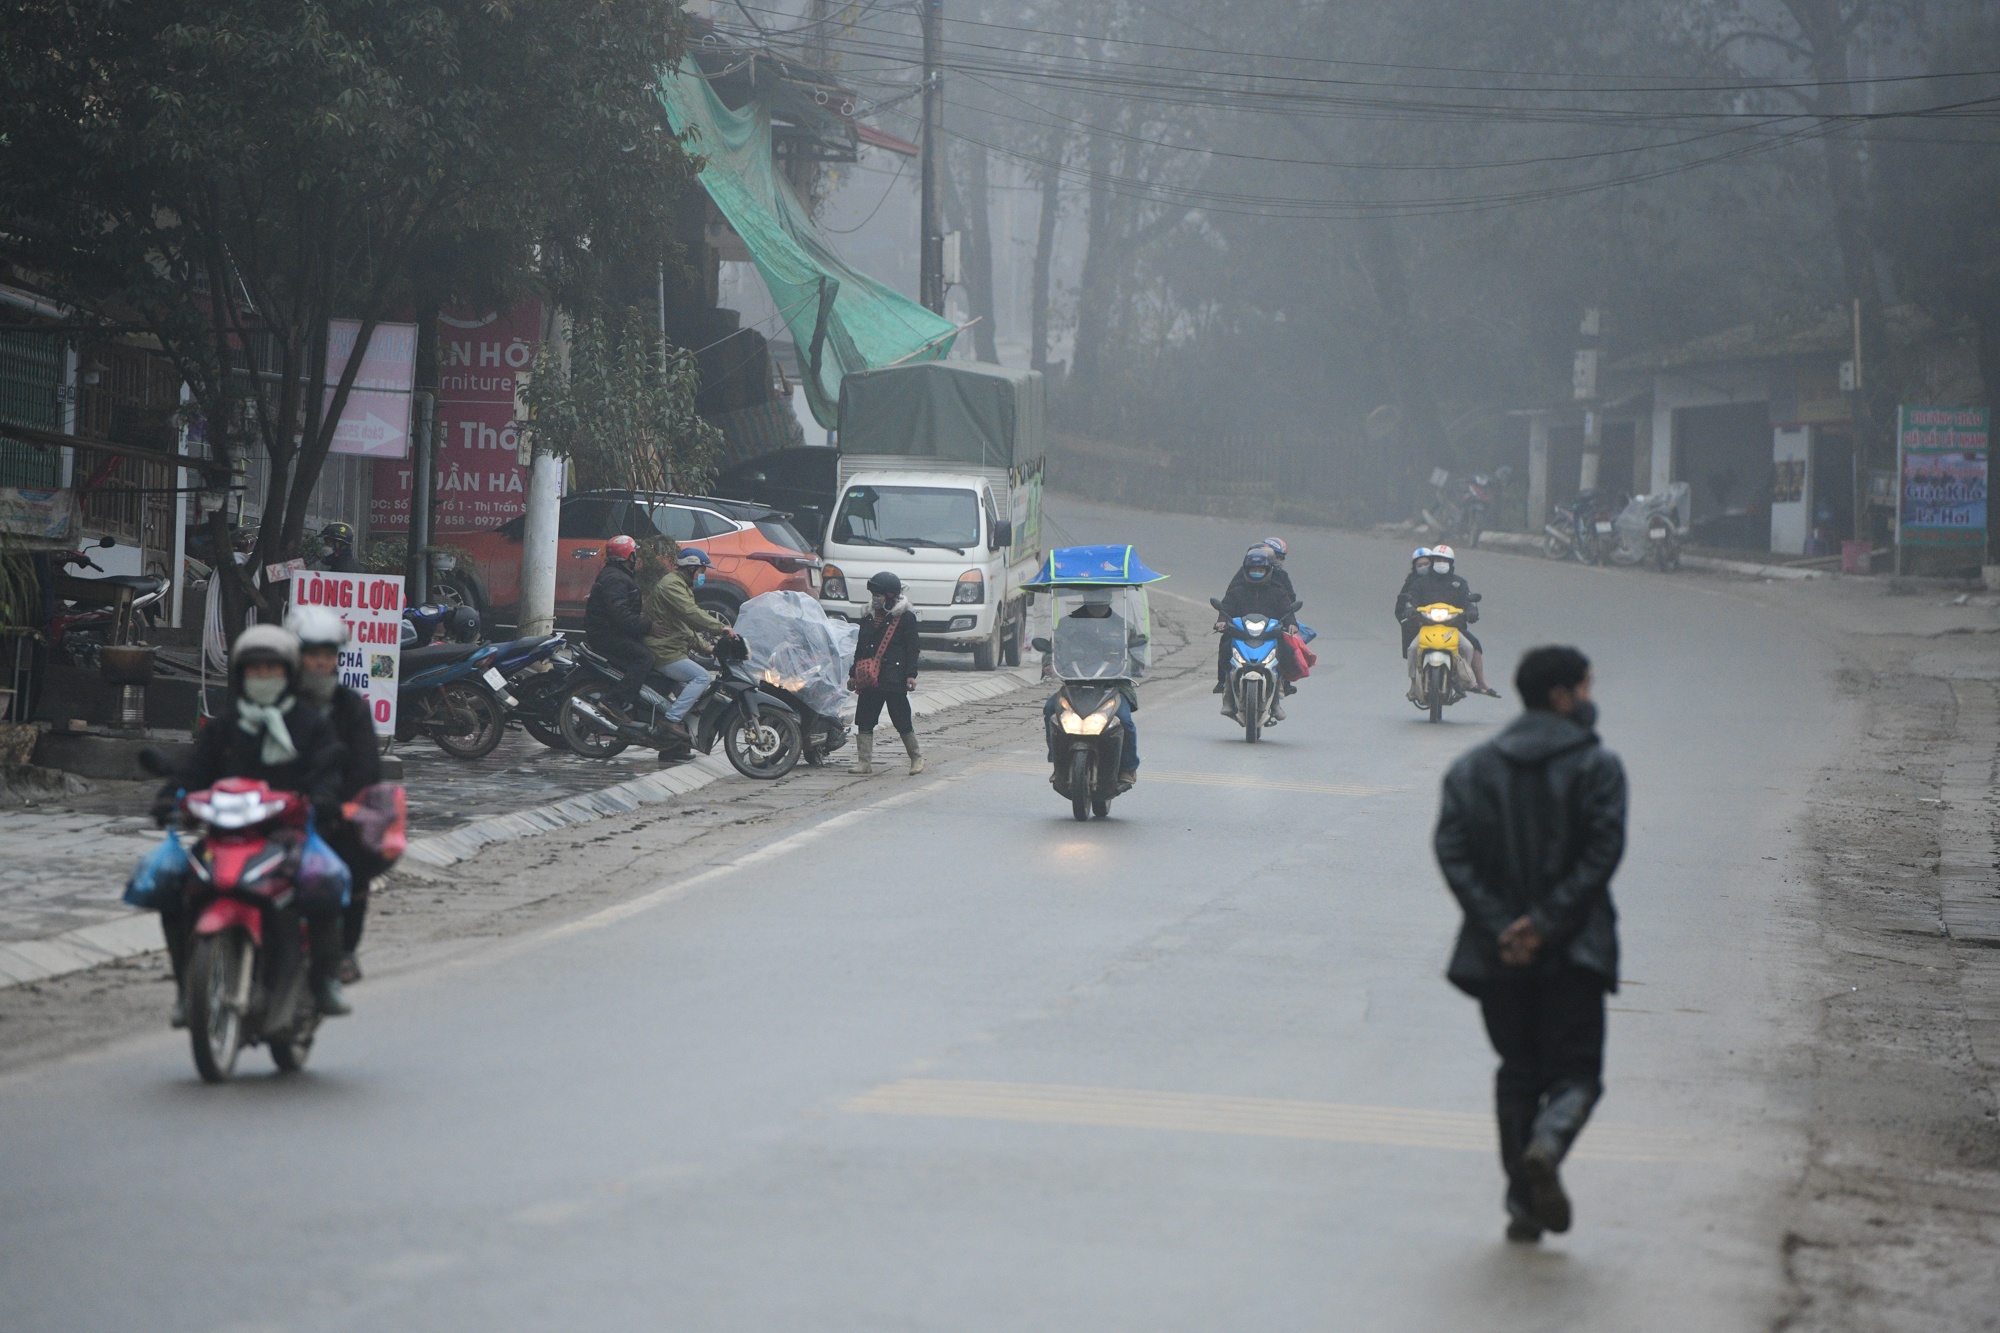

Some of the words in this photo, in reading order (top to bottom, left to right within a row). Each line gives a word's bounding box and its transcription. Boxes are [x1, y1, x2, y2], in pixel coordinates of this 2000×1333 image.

[479, 337, 537, 368] HÒ
[439, 373, 512, 392] rniture
[394, 498, 409, 510] Số
[475, 501, 491, 514] Thị
[493, 500, 518, 512] Trấn
[390, 514, 410, 524] 098
[444, 515, 465, 525] 858
[475, 516, 502, 526] 0972
[297, 573, 353, 608] LÒNG
[357, 579, 399, 616] LỢN
[358, 620, 398, 645] CANH
[338, 647, 363, 668] CHẢ
[343, 669, 369, 689] ÒNG
